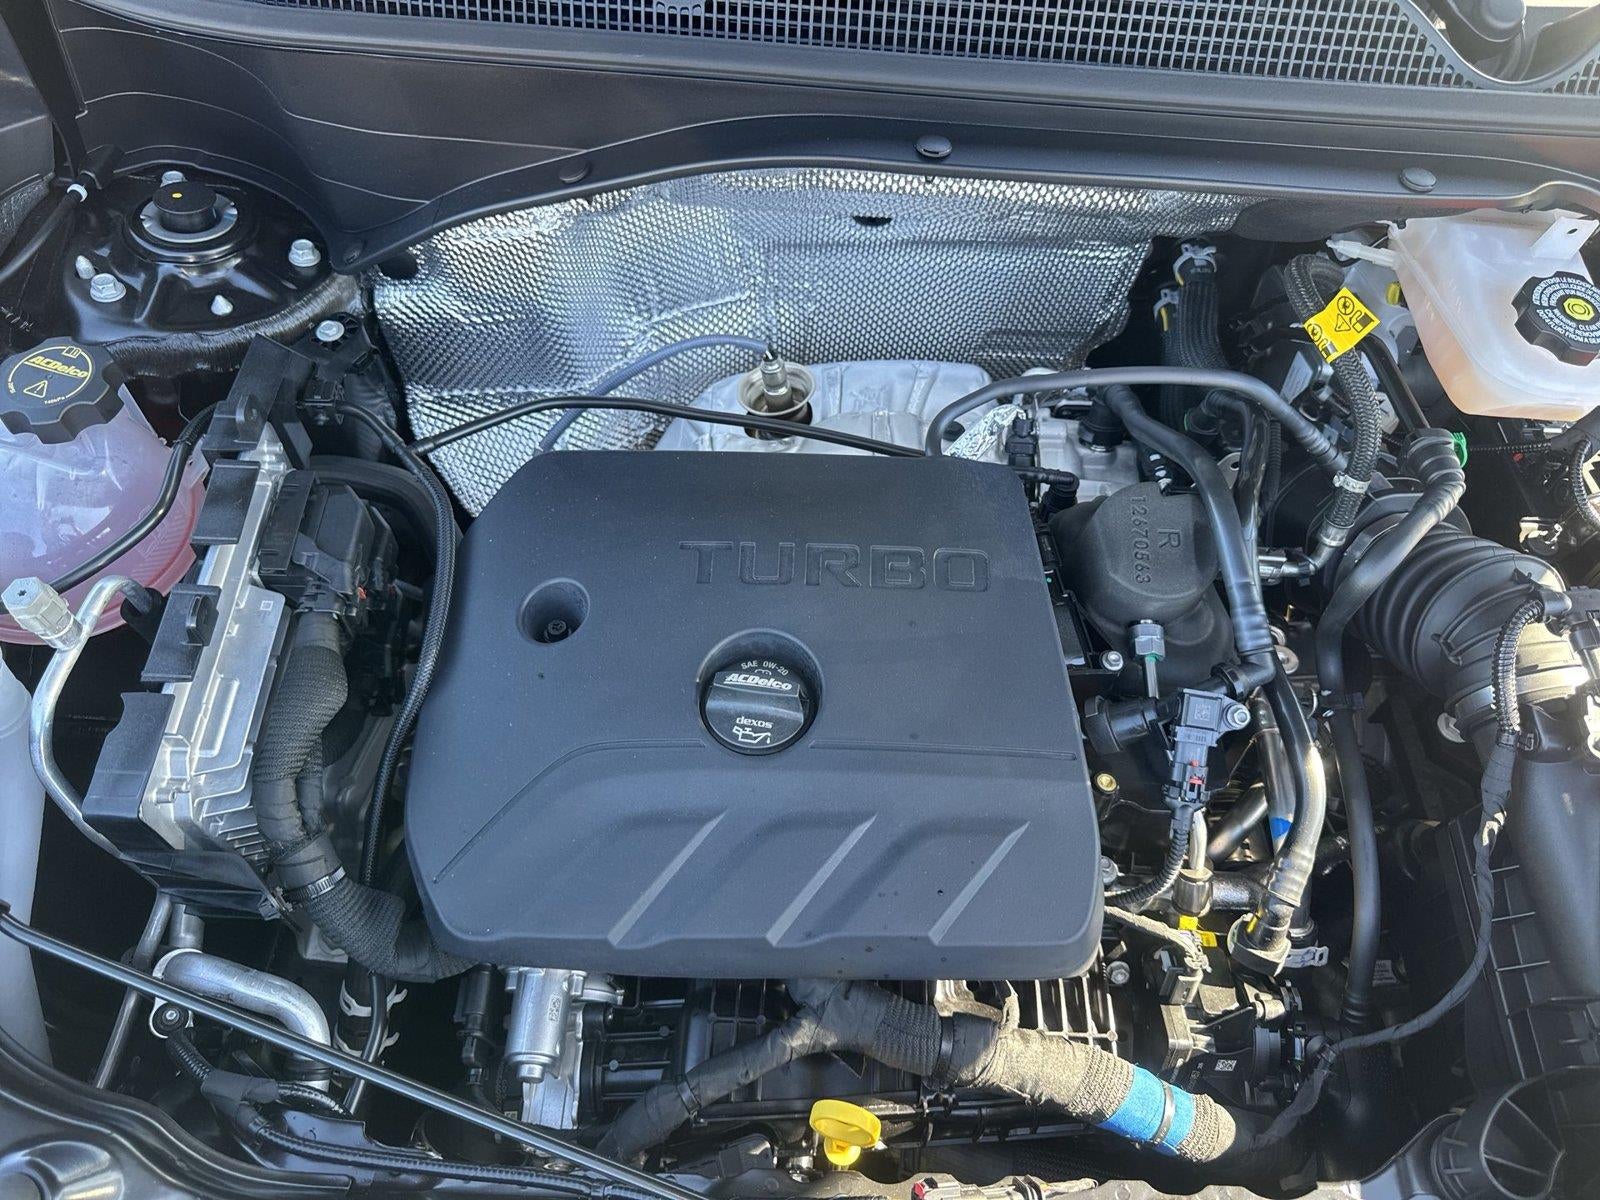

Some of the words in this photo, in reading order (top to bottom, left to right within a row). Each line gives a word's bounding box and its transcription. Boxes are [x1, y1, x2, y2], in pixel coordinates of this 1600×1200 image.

[1565, 331, 1584, 342] FROM
[23, 355, 90, 379] ACDelco
[1130, 495, 1152, 585] 12670563
[1158, 528, 1181, 549] R
[678, 540, 991, 592] TURBO
[741, 660, 758, 670] SAE
[763, 661, 789, 676] 0W-20
[723, 673, 793, 690] ACDelco
[736, 716, 774, 729] dexos
